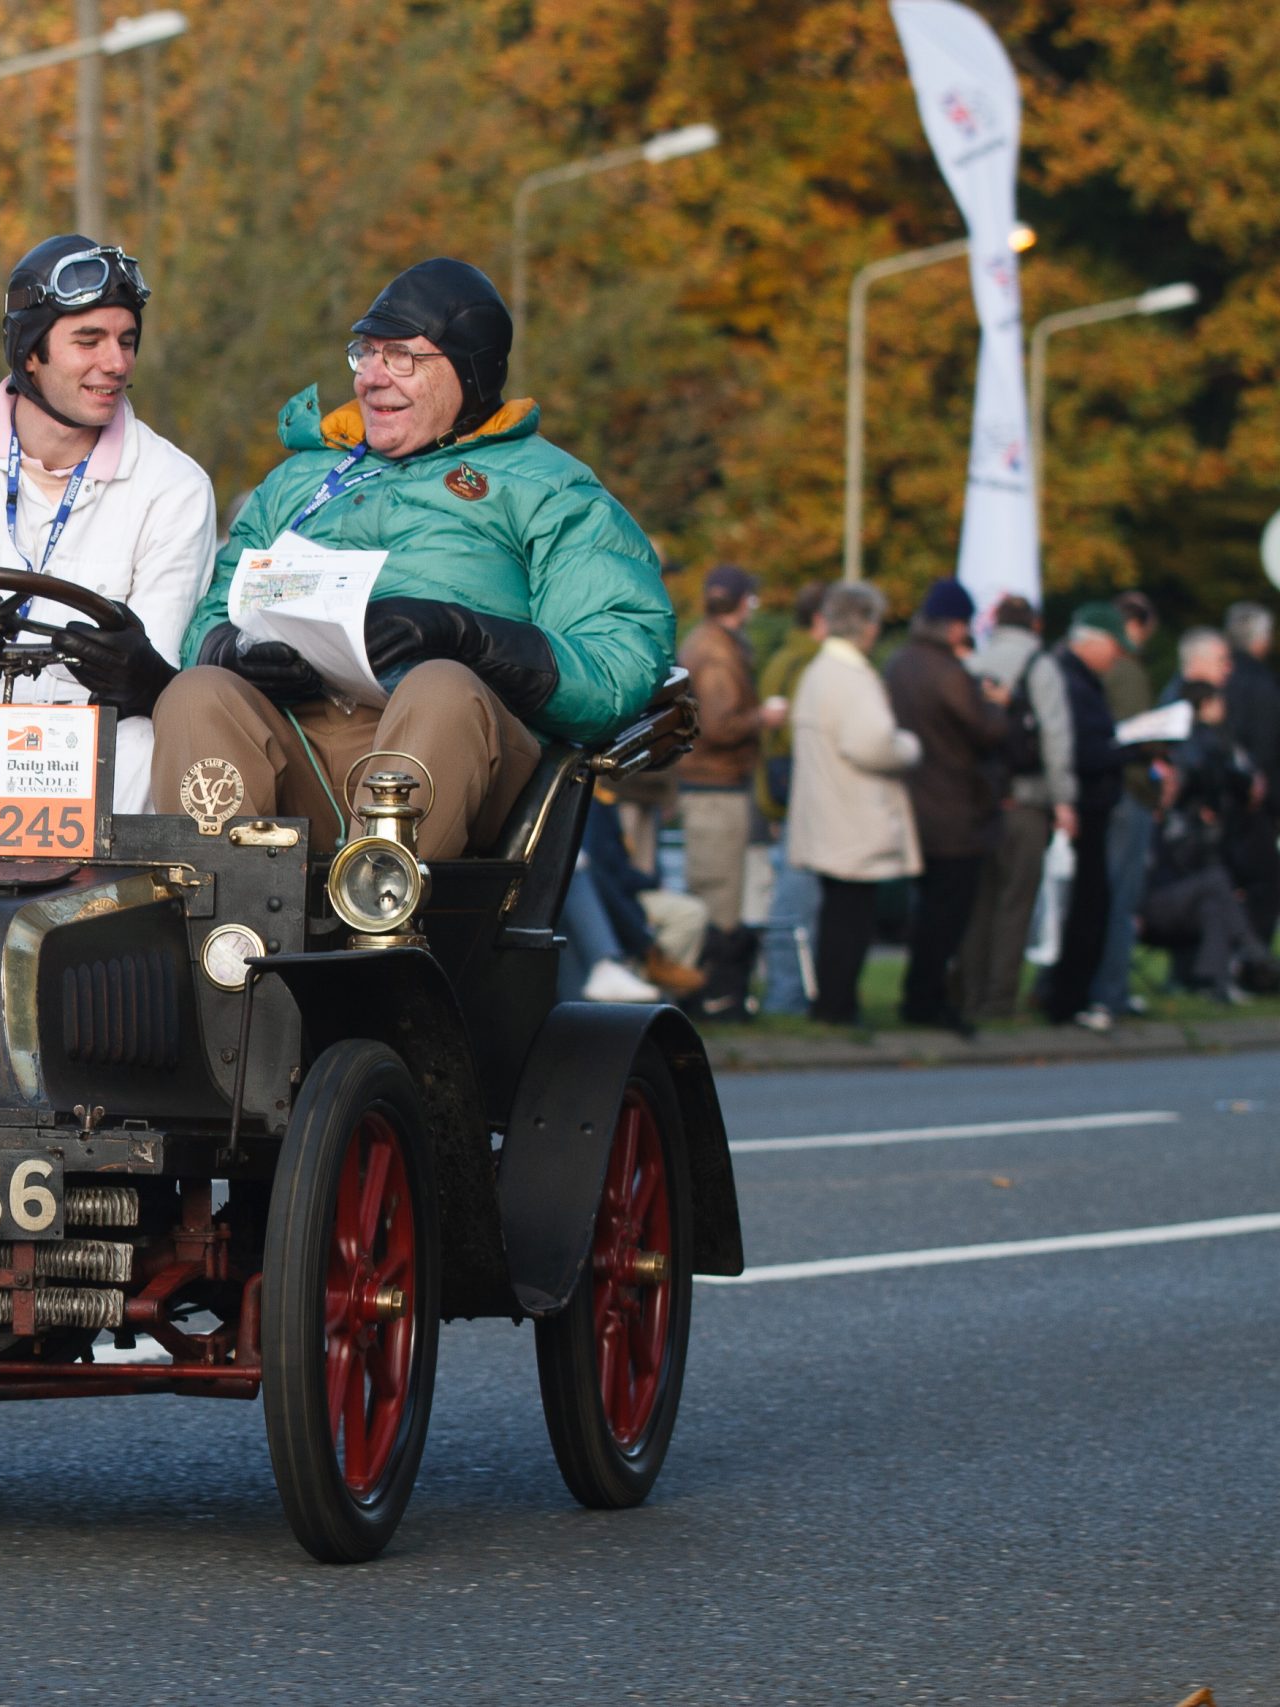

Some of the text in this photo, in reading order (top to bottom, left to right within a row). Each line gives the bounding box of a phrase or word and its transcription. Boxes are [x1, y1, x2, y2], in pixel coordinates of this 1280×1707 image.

[7, 759, 79, 775] Daily Mail
[16, 777, 78, 787] TINDLE
